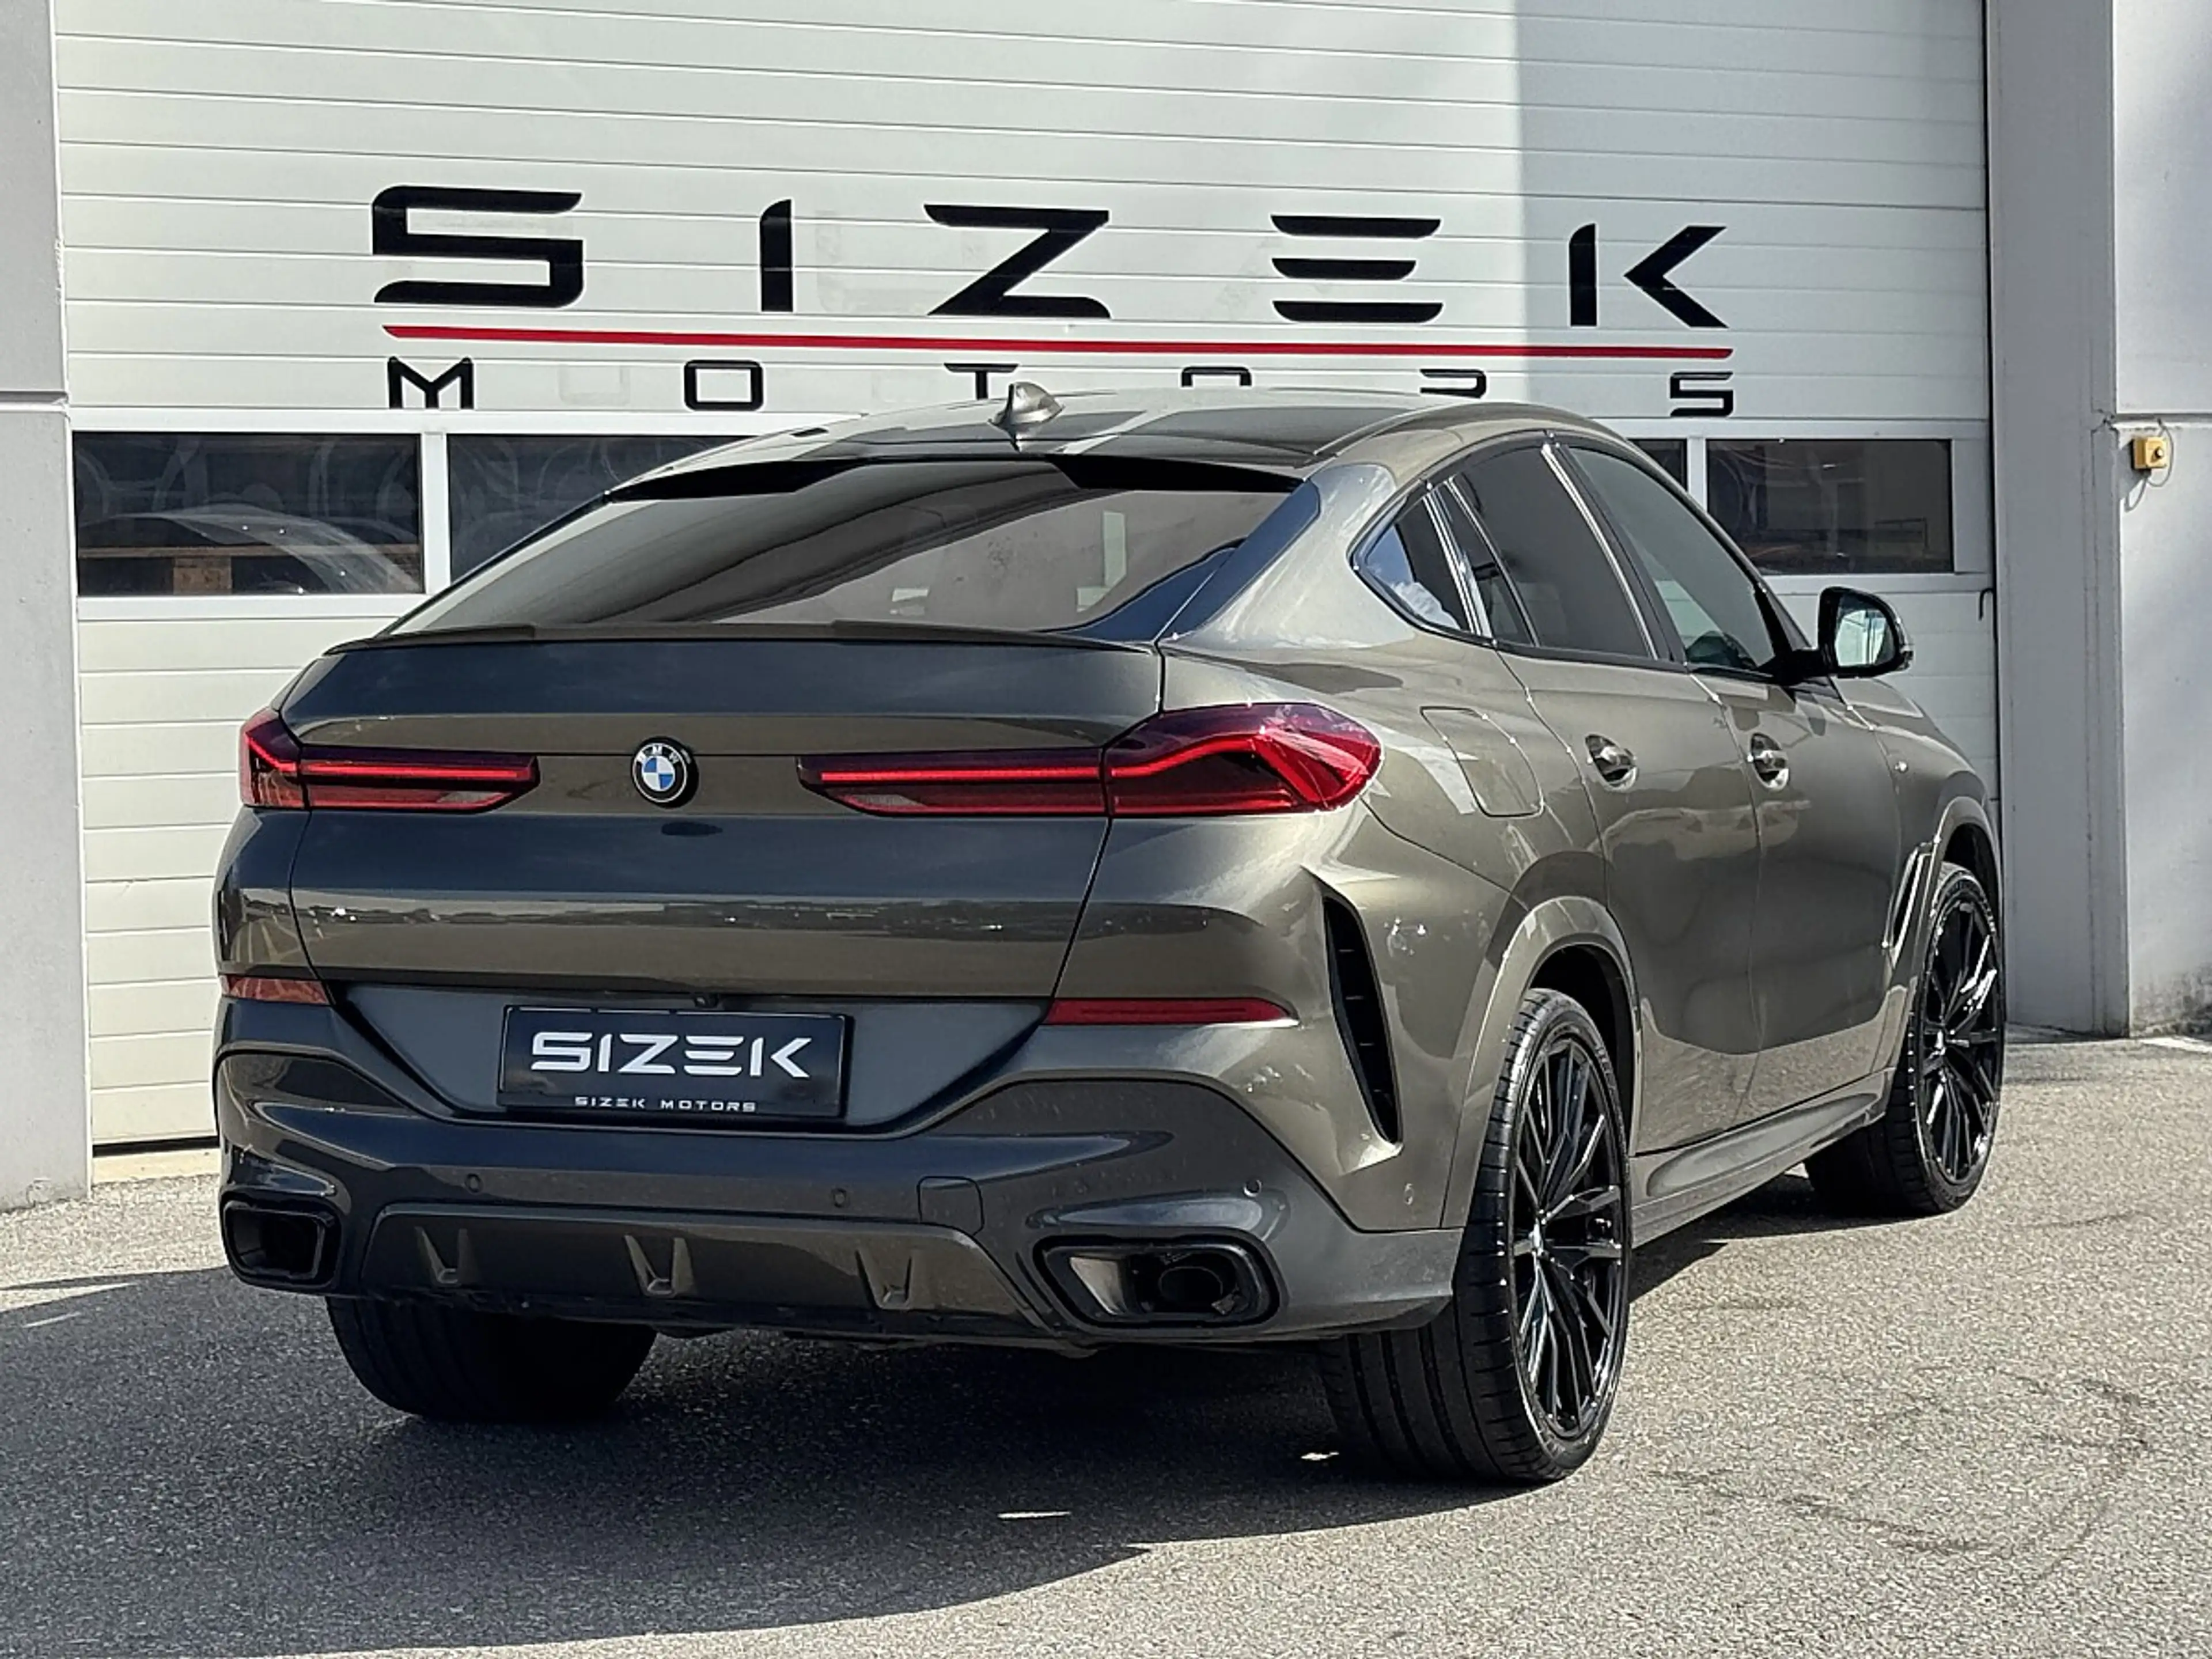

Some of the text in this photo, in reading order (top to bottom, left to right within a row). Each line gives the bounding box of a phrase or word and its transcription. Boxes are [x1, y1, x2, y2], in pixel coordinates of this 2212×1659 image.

[372, 185, 1728, 329] SIZEK
[531, 1031, 812, 1078] SIZEK
[575, 1096, 755, 1112] SIZEK MOTORS
